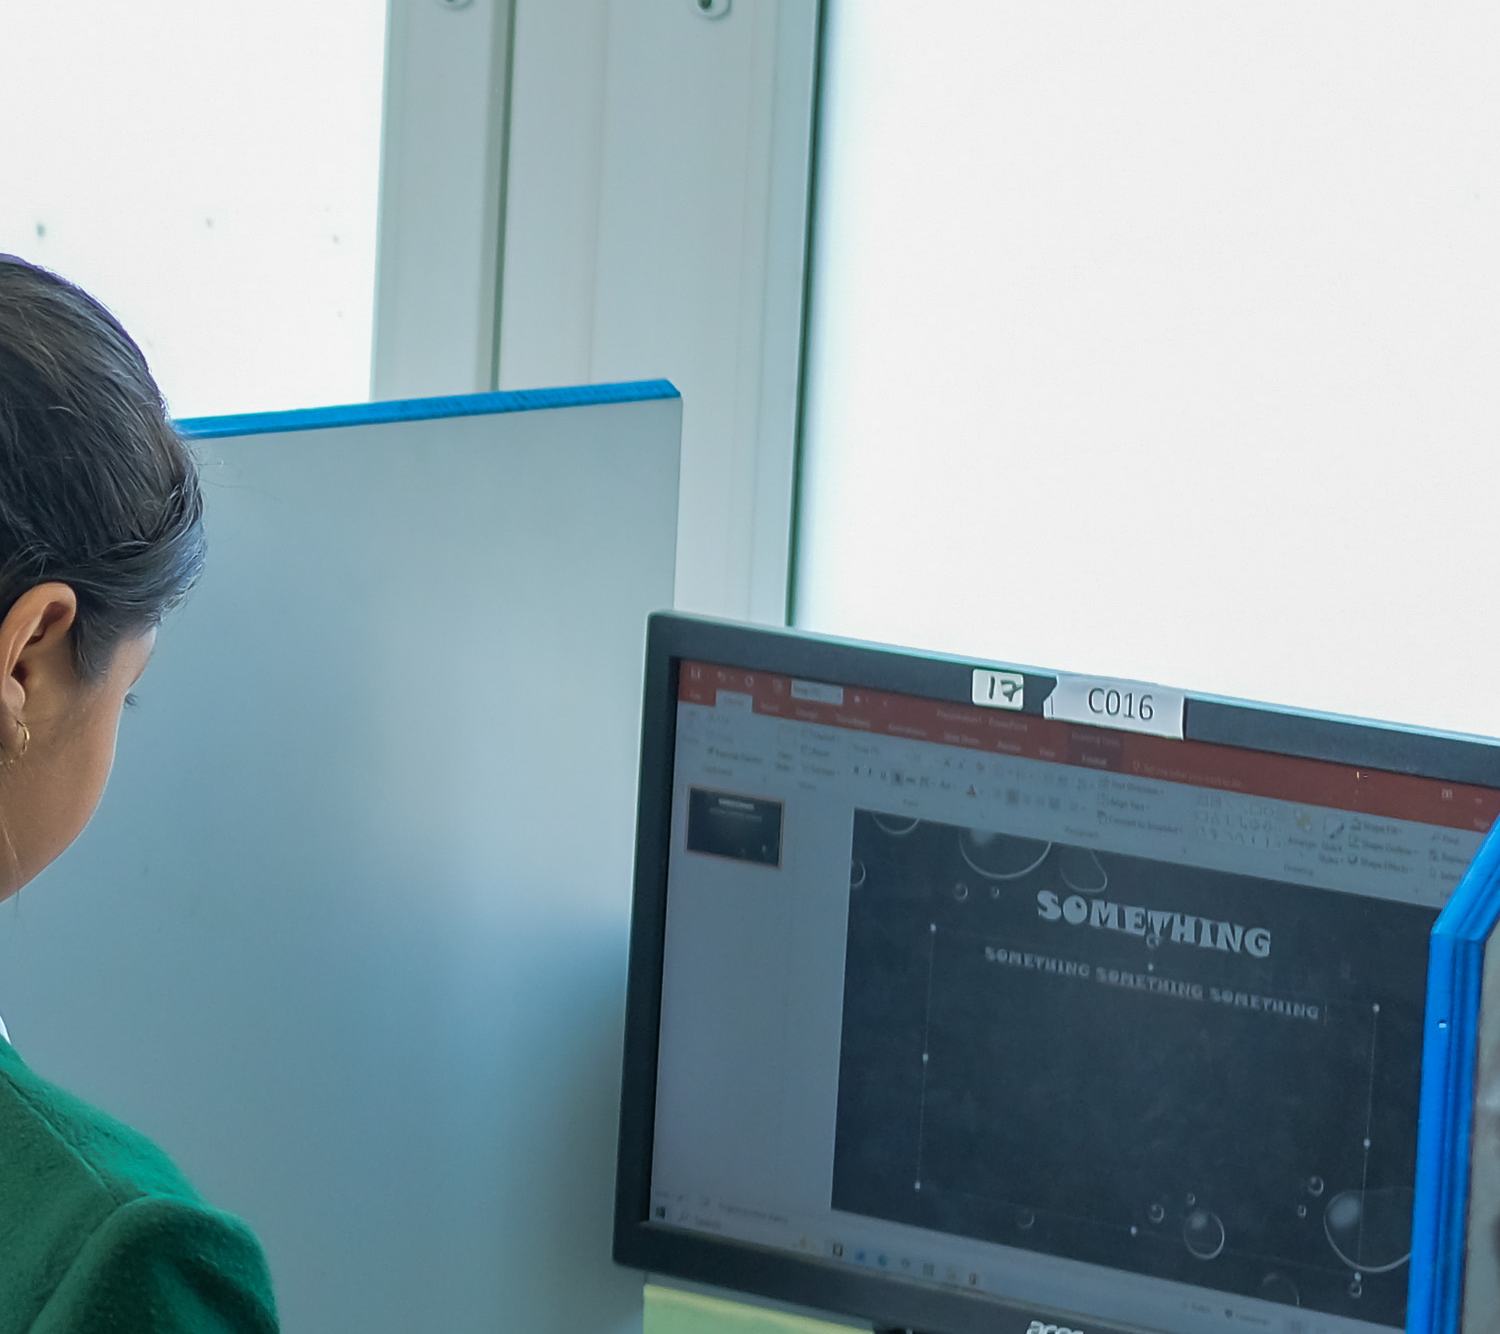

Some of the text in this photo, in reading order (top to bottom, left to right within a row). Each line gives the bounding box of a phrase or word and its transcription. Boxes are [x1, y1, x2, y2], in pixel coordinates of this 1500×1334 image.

[1088, 687, 1154, 721] C016
[1036, 889, 1272, 958] SOMETHING
[984, 945, 1320, 1020] SOMETHING SOMETHING SOMETHING
